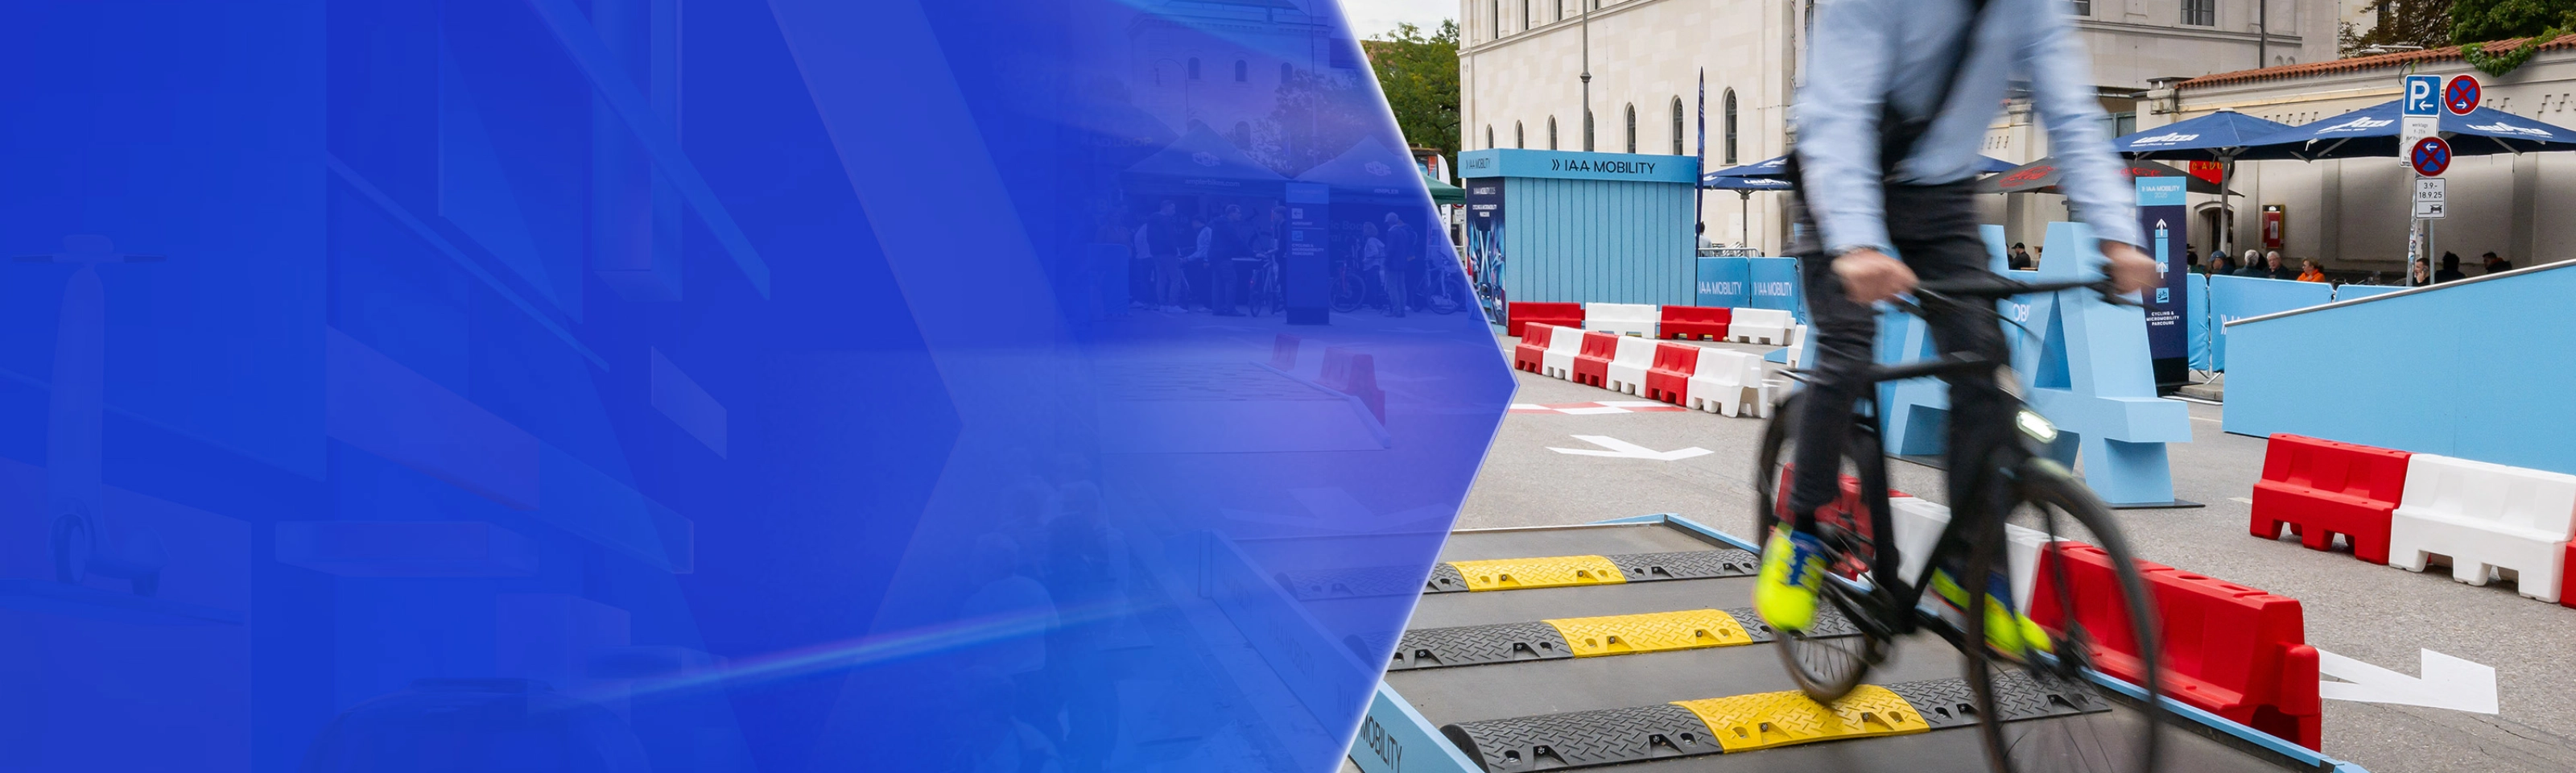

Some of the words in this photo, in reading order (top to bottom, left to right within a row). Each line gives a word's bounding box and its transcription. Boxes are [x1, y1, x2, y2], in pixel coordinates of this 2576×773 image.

[2409, 81, 2430, 110] P
[1564, 159, 1590, 172] IAA
[1593, 160, 1656, 174] MOBILITY
[1699, 281, 1711, 295] IAA
[1712, 281, 1742, 296] MOBILITY
[1768, 282, 1793, 296] MOBILITY
[1360, 713, 1402, 773] MOBILITY
